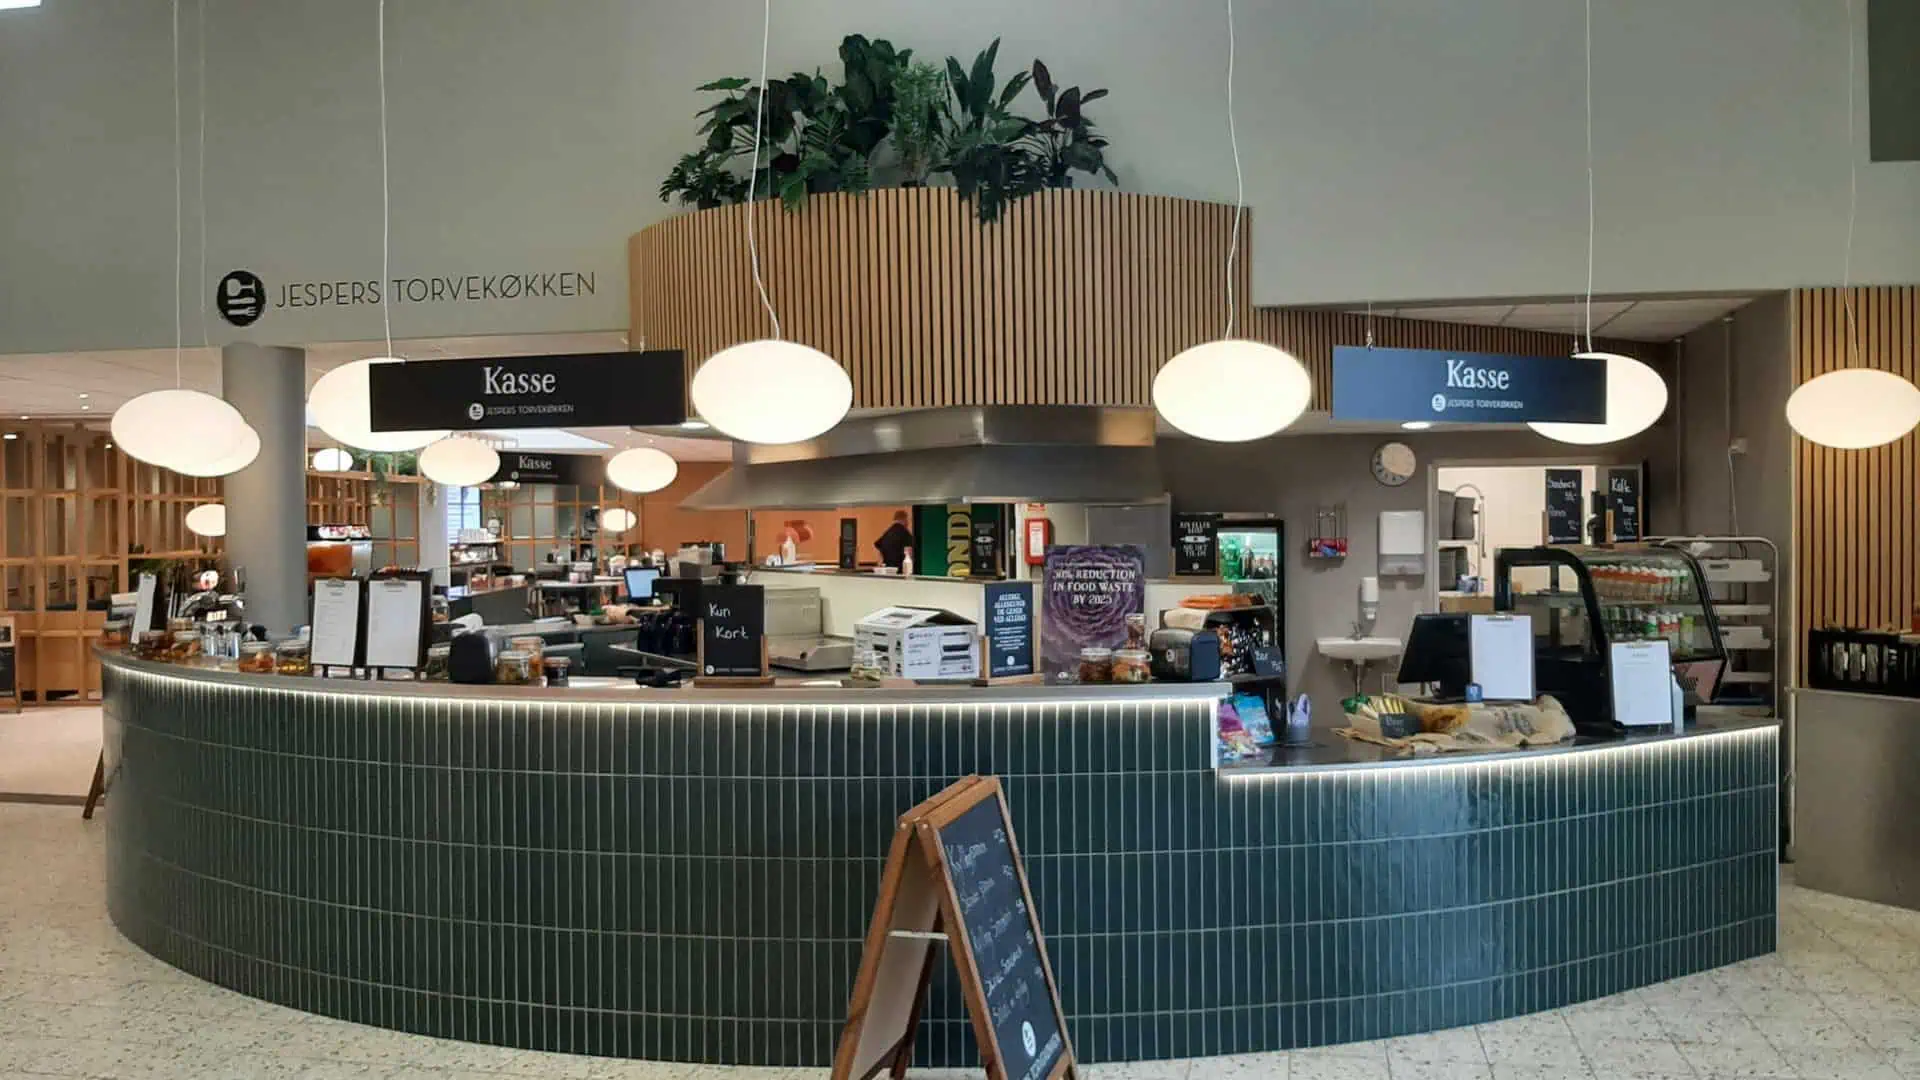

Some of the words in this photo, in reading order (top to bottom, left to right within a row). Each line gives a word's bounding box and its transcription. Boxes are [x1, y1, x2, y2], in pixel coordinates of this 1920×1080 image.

[276, 280, 381, 309] JESPERS
[392, 271, 595, 303] TORVEKØKKEN
[483, 365, 556, 395] Kasse
[1446, 359, 1510, 390] Kasse
[519, 455, 552, 471] Kasse
[1075, 569, 1136, 580] REDUCTION
[1053, 581, 1065, 592] IN
[1067, 581, 1097, 592] FOOD
[1098, 581, 1135, 593] WASTE
[1073, 594, 1087, 605] BY
[708, 602, 732, 619] Kun
[715, 625, 749, 640] Kort
